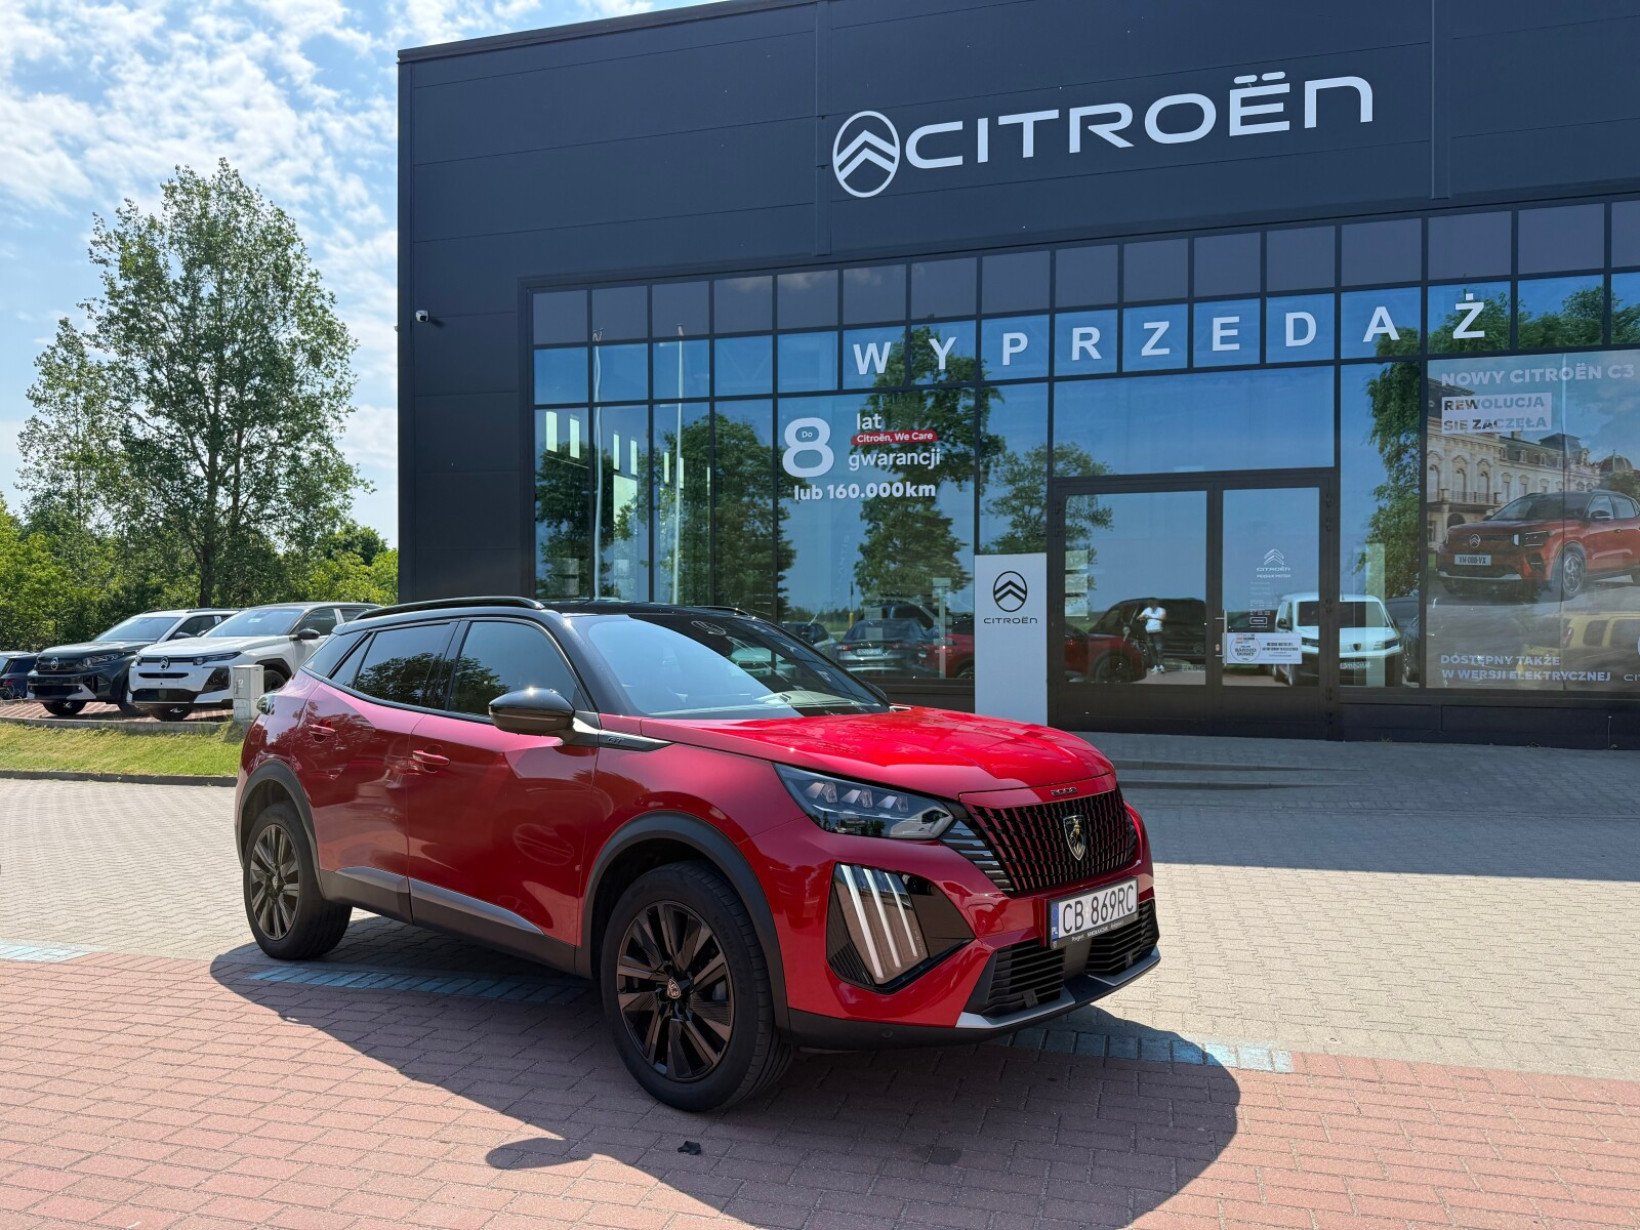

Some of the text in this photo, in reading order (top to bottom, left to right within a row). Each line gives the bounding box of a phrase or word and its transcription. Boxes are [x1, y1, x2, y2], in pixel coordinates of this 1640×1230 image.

[906, 71, 1374, 169] CITROËN
[1441, 362, 1635, 387] NOWY CITROËN C3
[1443, 396, 1545, 411] REWOLUCJA
[856, 413, 883, 430] lat
[856, 431, 934, 443] Citroën, We Care
[782, 417, 834, 478] 8
[848, 448, 941, 471] gwarancji
[793, 484, 824, 500] lub
[983, 616, 1038, 624] CITROËN
[1440, 653, 1560, 667] DOSTĘPNY TAKŻE
[1441, 669, 1456, 679] W
[1509, 670, 1611, 682] ELEKTRYCZNEJ
[1063, 884, 1134, 934] CB 869RC
